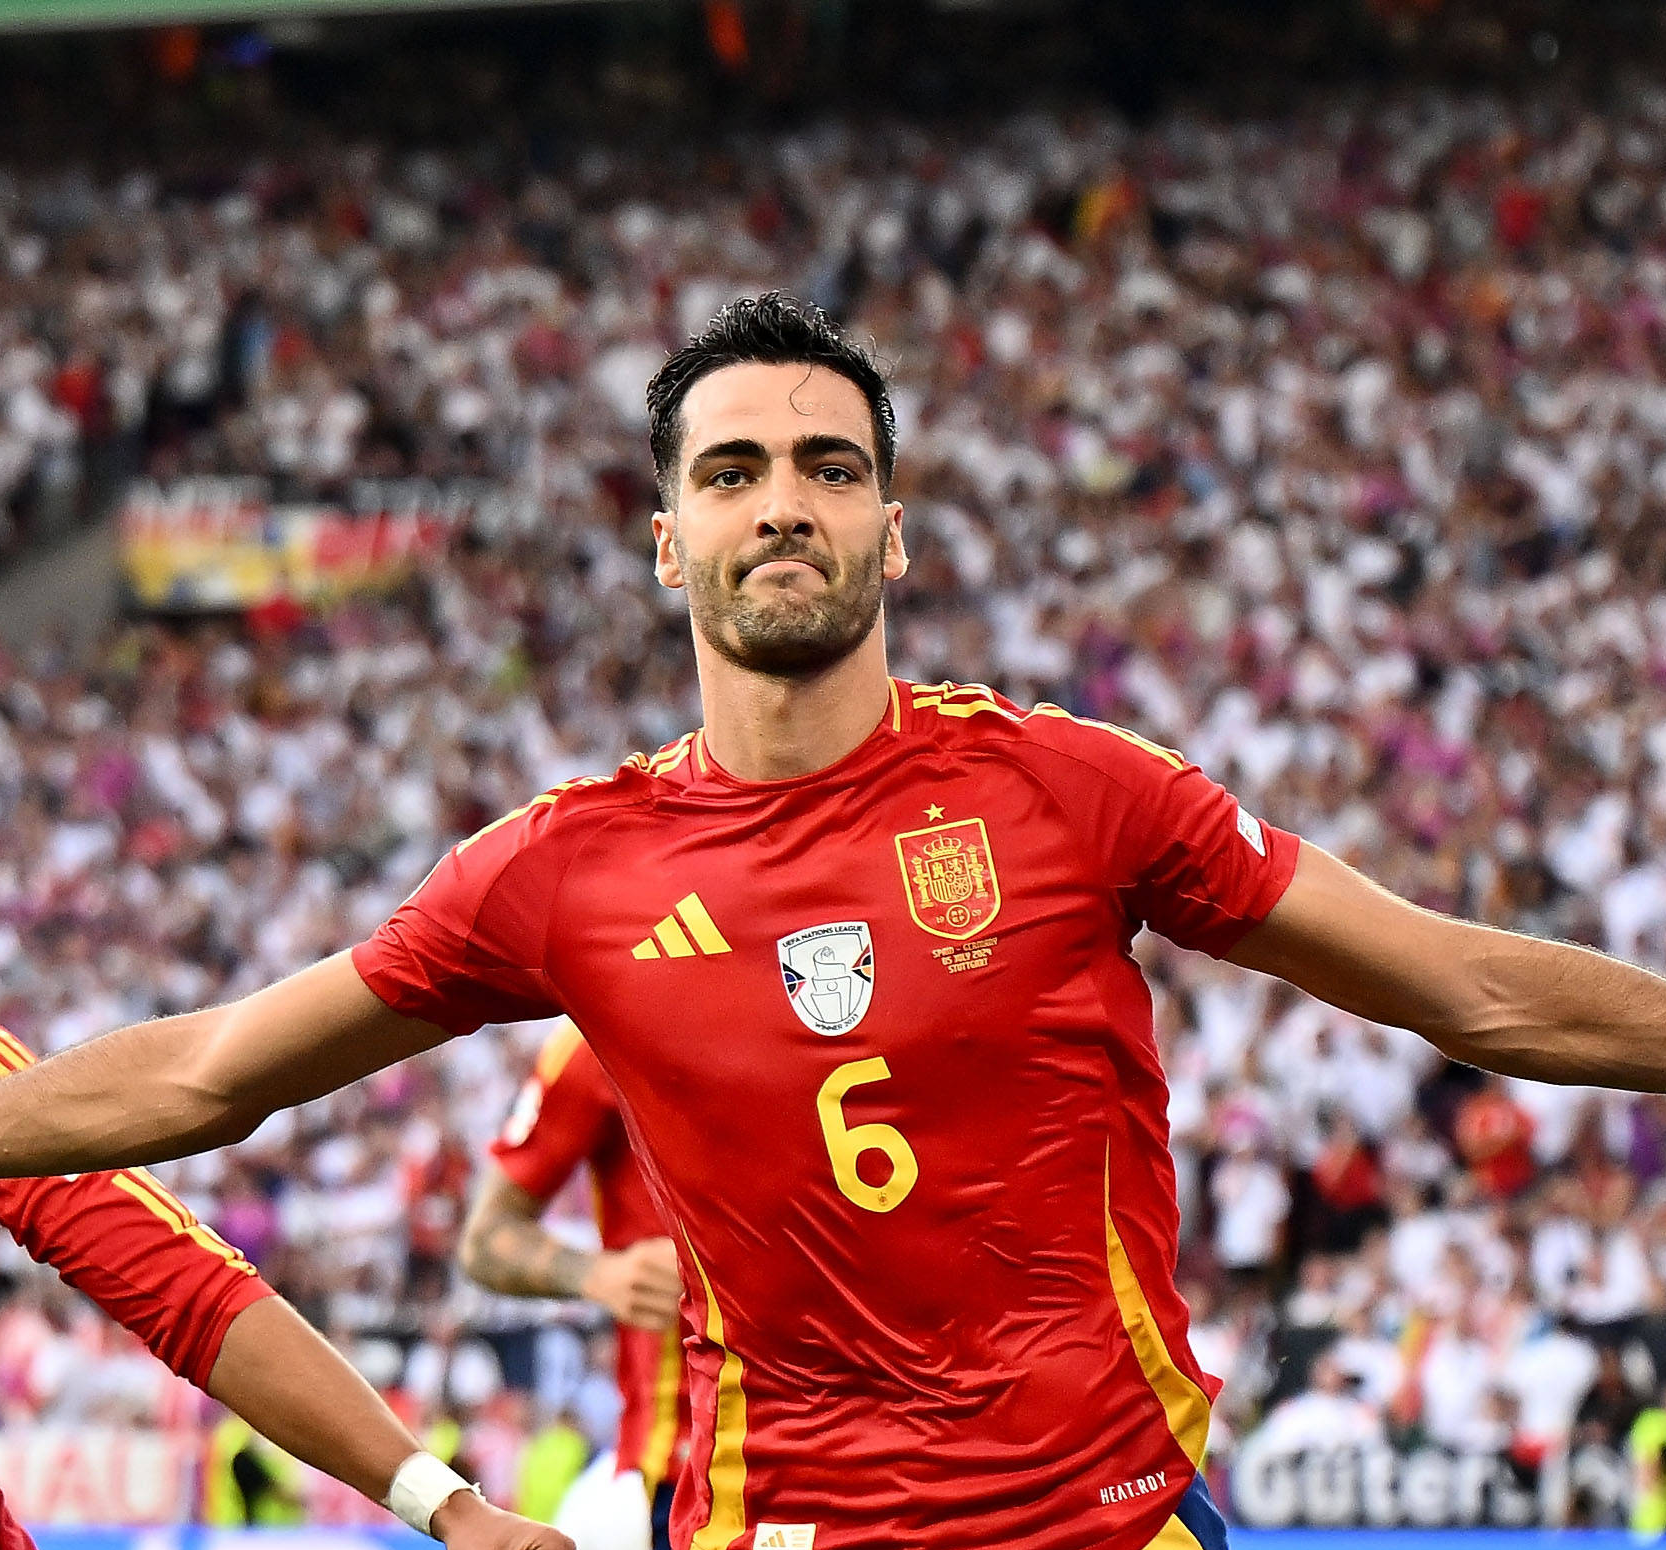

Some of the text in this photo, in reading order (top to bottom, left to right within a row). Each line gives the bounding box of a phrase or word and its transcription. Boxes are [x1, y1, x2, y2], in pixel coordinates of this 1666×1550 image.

[801, 927, 833, 941] NATIONS
[834, 925, 864, 933] LEAGUE
[816, 1055, 919, 1213] 6
[1100, 1470, 1167, 1505] HEAT.RDY
